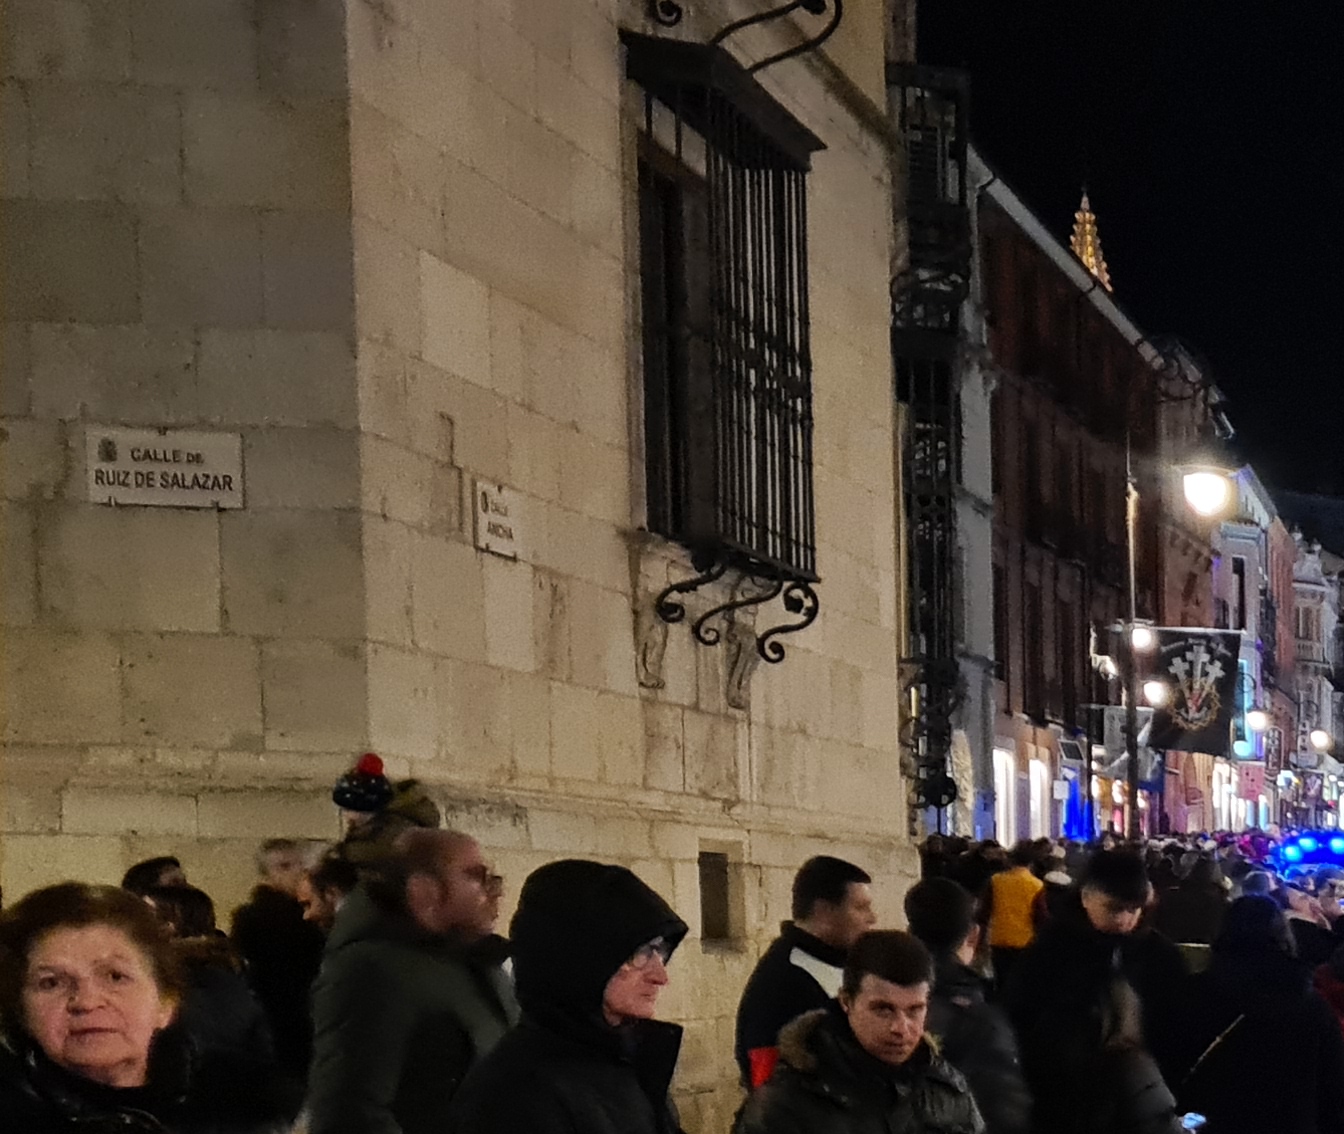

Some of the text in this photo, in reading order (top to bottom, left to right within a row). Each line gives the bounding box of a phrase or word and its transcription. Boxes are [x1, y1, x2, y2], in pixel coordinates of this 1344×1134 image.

[131, 449, 204, 464] CALLE DE
[94, 469, 233, 491] RUIZ DE SALAZAR
